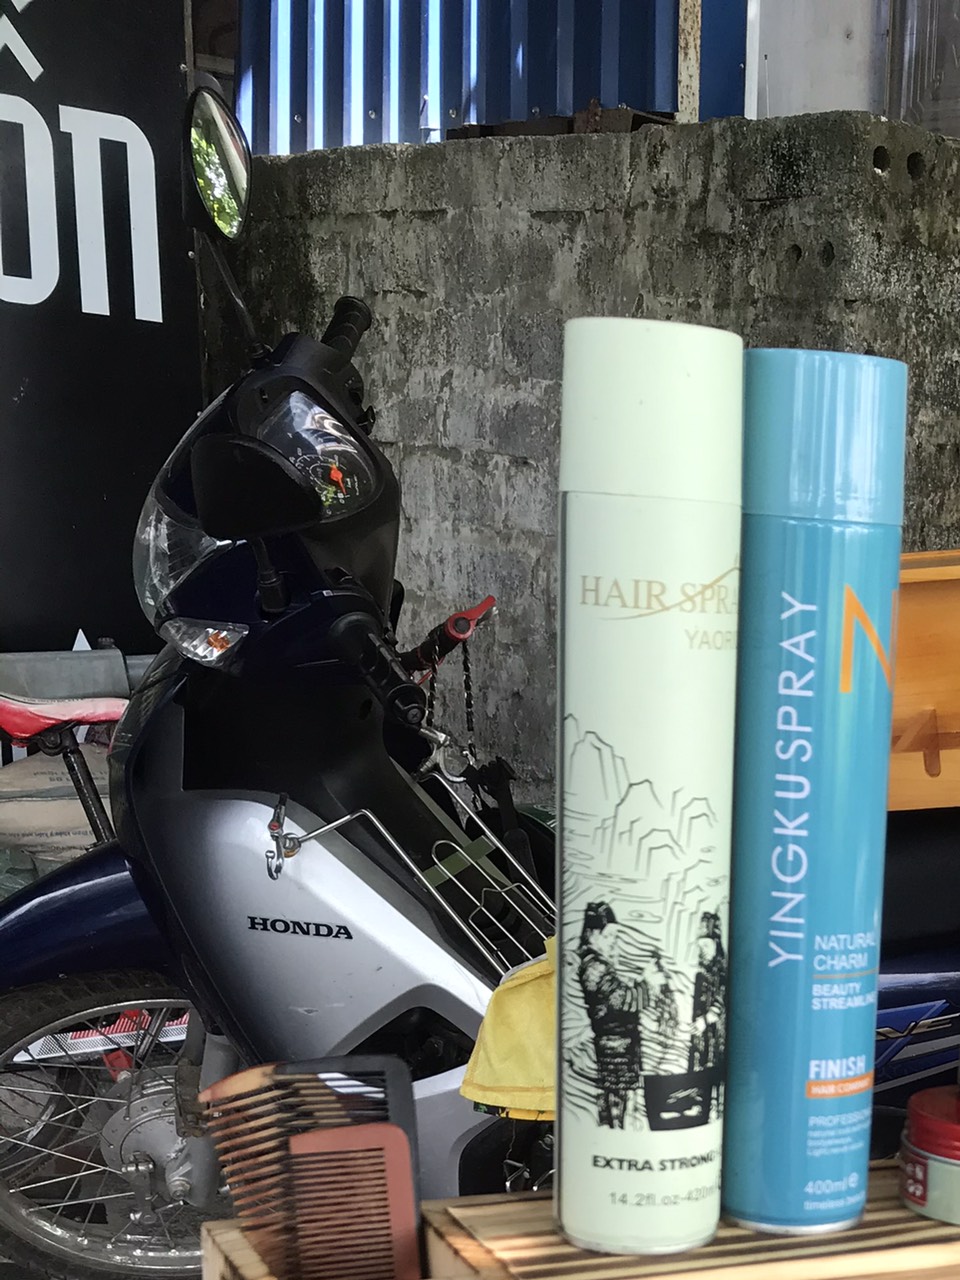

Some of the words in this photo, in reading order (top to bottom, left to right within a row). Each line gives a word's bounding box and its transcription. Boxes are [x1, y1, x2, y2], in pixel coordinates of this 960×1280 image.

[579, 575, 670, 610] HAIR
[768, 590, 818, 968] YINGKUSPRAY
[247, 916, 353, 940] HONDA
[813, 953, 868, 971] CHARM
[811, 982, 862, 997] BEAUTY
[809, 1055, 866, 1080] FINISH
[593, 1155, 653, 1172] EXTRA
